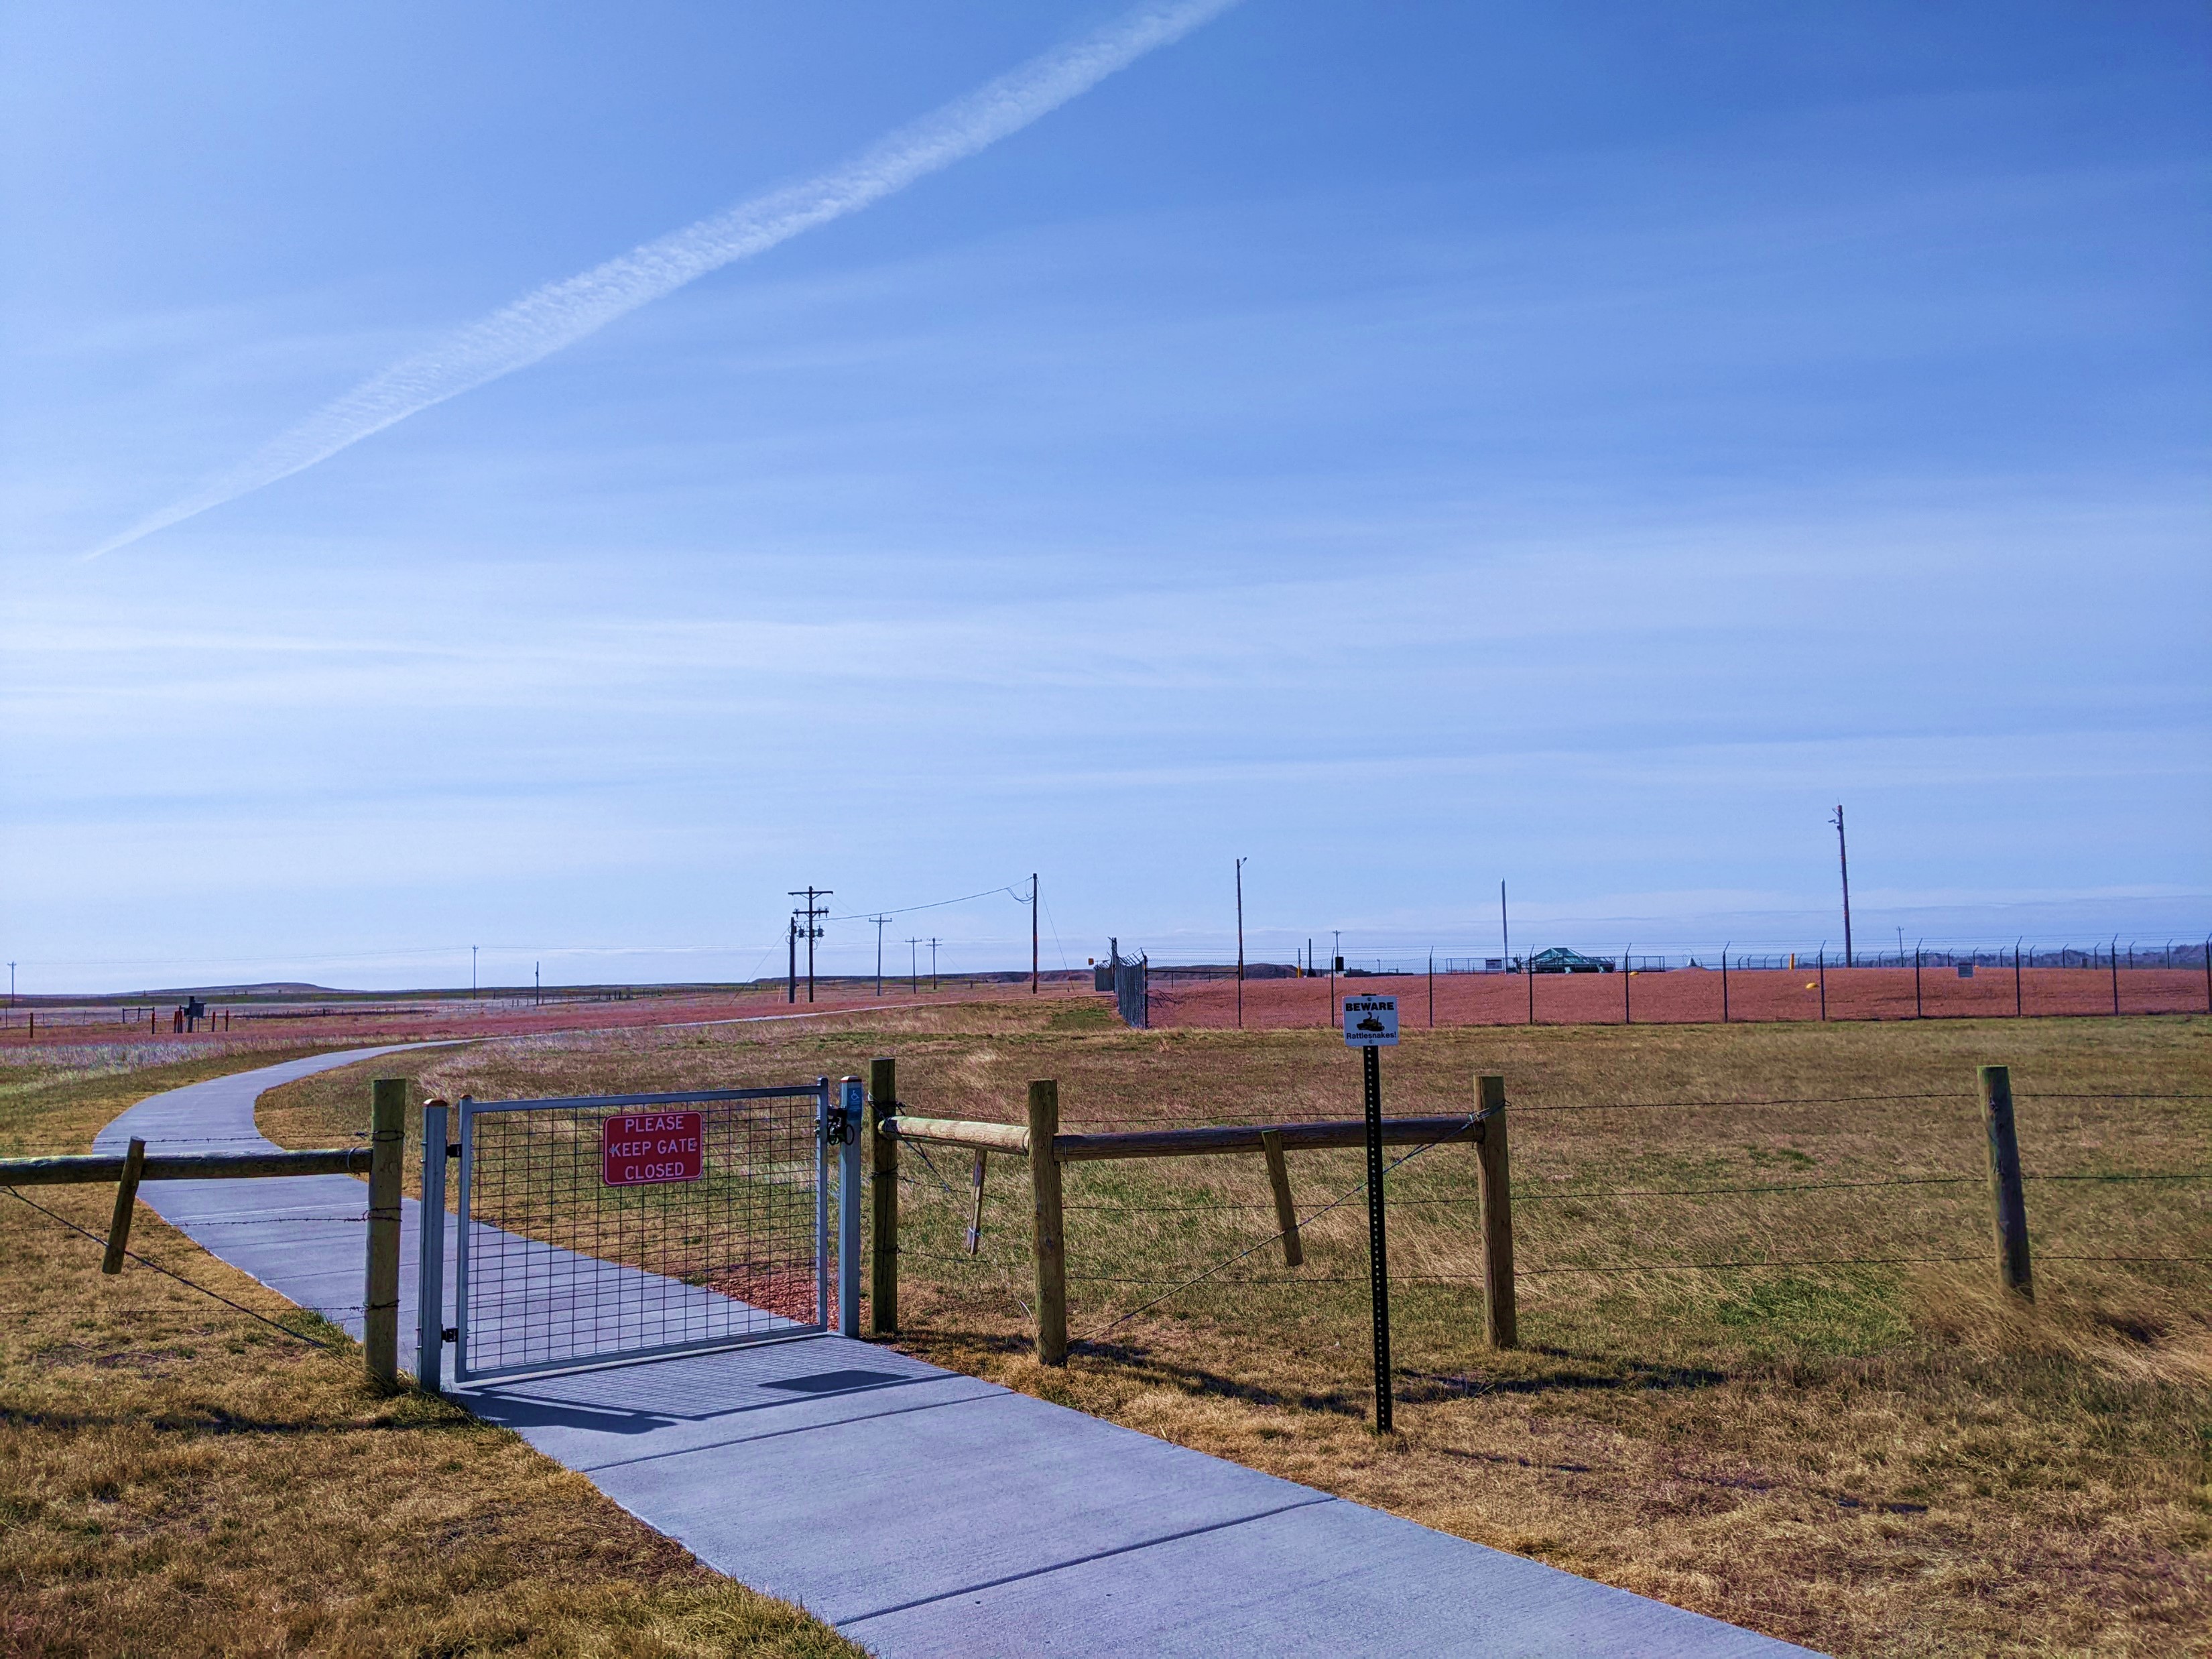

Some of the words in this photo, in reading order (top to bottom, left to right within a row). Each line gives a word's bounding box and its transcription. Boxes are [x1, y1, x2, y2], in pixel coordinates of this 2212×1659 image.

[1345, 1002, 1394, 1011] BEWARE
[625, 1115, 684, 1133] PLEASE
[611, 1142, 652, 1157] KEEP
[658, 1138, 696, 1154] GATE
[625, 1162, 684, 1180] CLOSED
